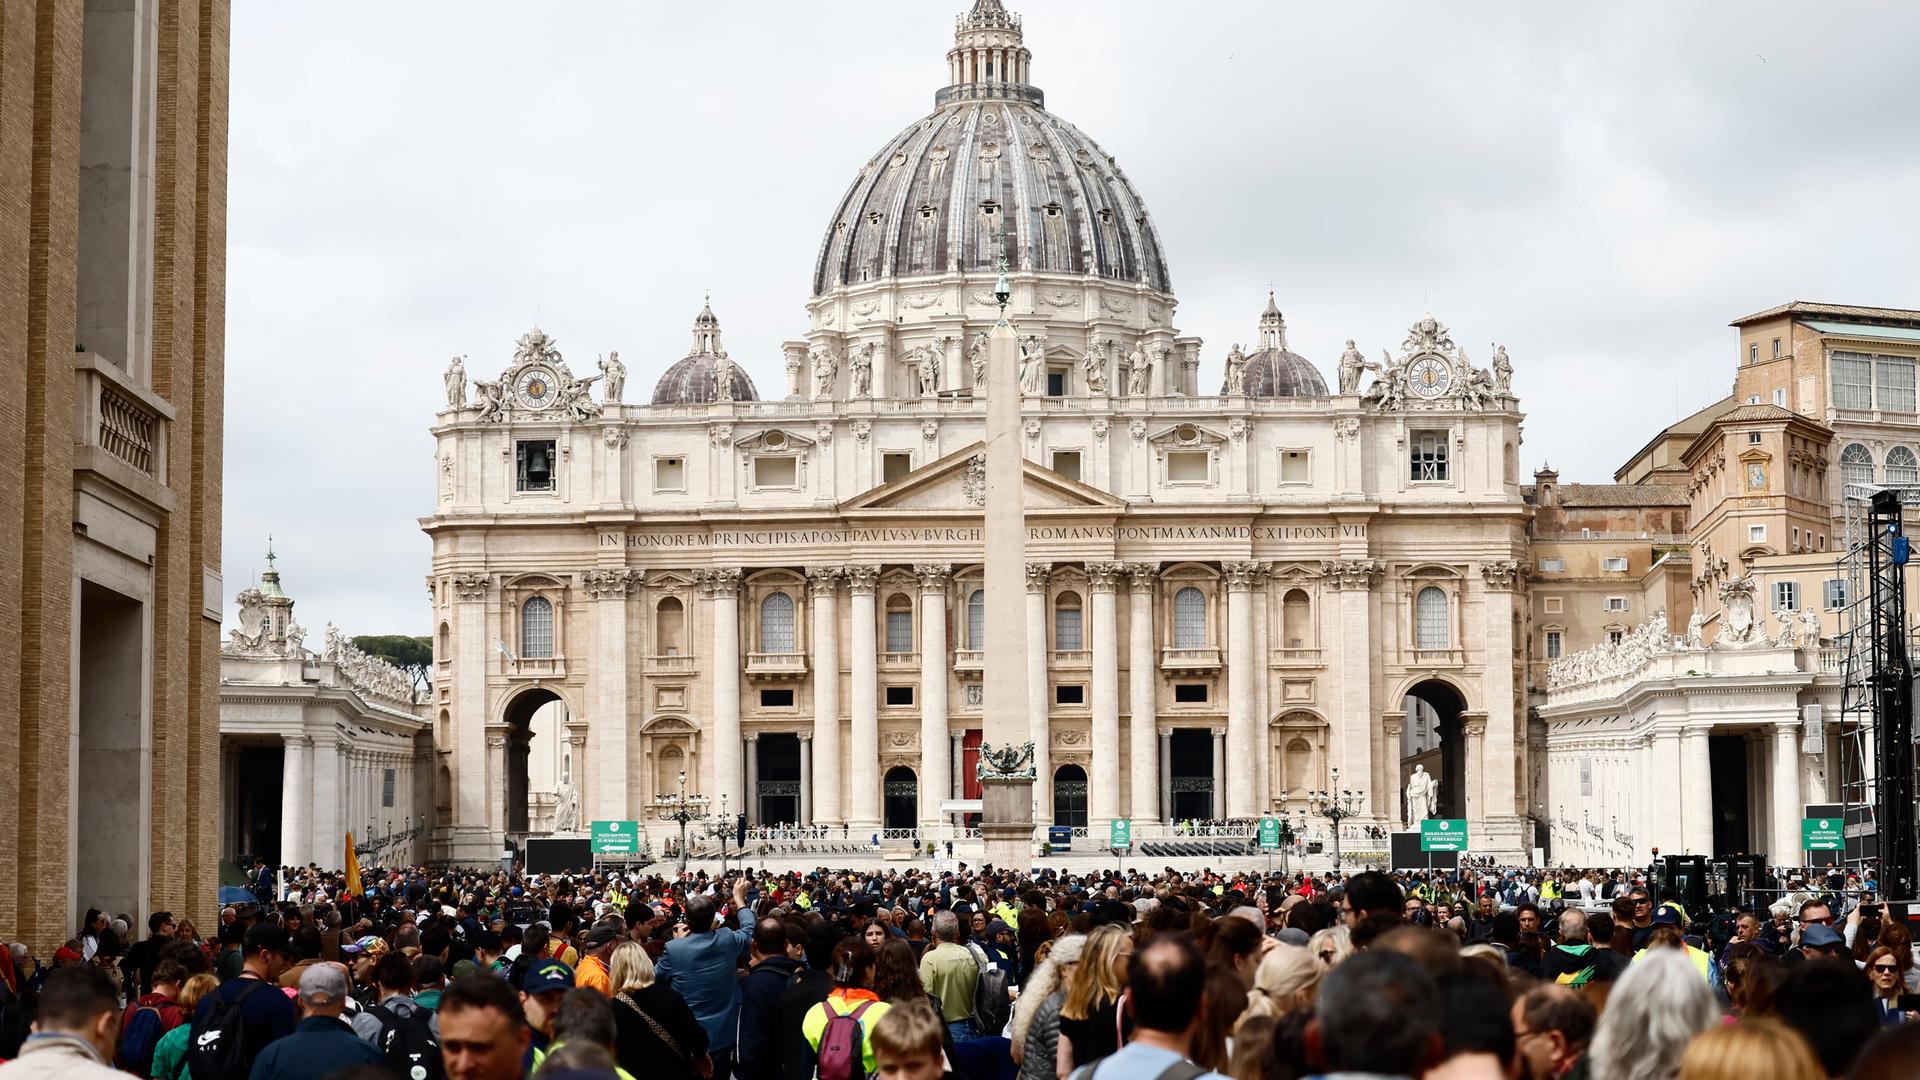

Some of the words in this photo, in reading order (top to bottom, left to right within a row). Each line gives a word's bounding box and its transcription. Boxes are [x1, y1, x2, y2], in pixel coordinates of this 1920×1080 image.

[600, 533, 618, 546] IN
[626, 533, 709, 547] HONOREM
[924, 528, 985, 541] BVRGH
[1029, 527, 1113, 540] ROMANVS
[1294, 526, 1336, 539] PONT
[1342, 525, 1366, 538] VII
